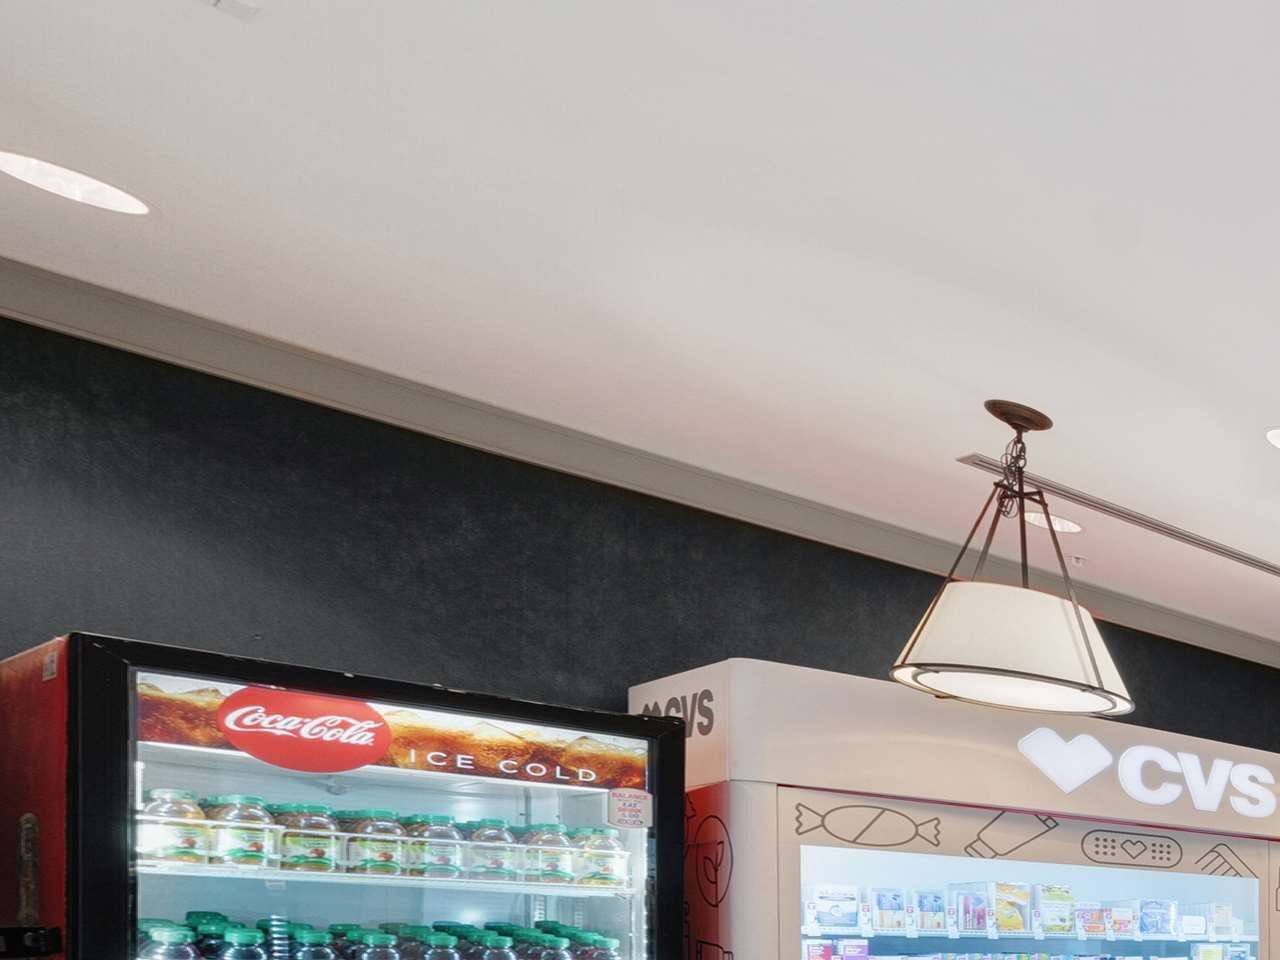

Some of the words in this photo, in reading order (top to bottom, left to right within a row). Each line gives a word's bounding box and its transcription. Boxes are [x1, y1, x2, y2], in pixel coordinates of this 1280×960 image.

[224, 705, 384, 746] Coca-Cola
[409, 748, 475, 769] ICE
[499, 759, 597, 782] COLD
[1118, 745, 1277, 818] CVS
